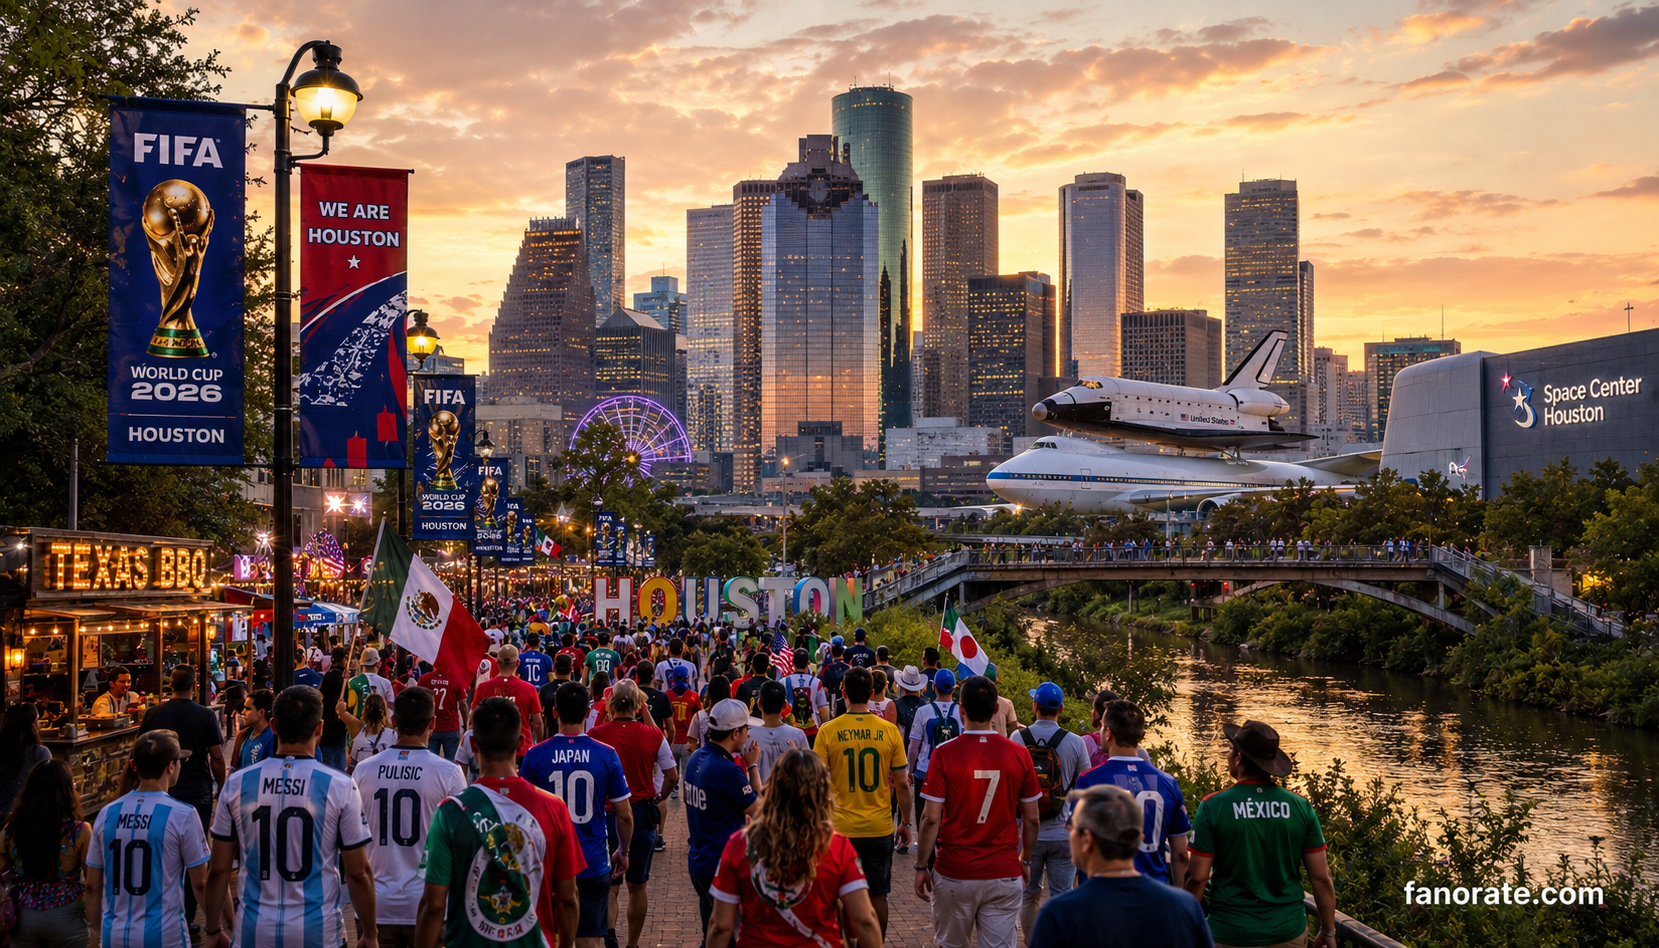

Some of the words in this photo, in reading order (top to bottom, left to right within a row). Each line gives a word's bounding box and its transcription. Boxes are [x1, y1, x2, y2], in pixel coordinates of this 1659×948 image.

[133, 132, 223, 168] FIFA
[319, 201, 348, 218] WE
[353, 203, 390, 220] ARE
[308, 227, 400, 247] HOUSTON
[130, 366, 188, 380] WORLD
[192, 369, 223, 381] CUP
[131, 382, 223, 403] 2026
[423, 389, 466, 405] FIFA
[1544, 384, 1587, 406] Space
[1590, 376, 1642, 399] Center
[1544, 405, 1605, 426] Houston
[128, 426, 225, 444] HOUSTON
[478, 466, 503, 475] FIFA
[422, 501, 466, 511] 2026
[421, 522, 467, 530] HOUSTON
[51, 542, 149, 590] TEXAS
[160, 547, 206, 590] BBQ
[593, 576, 864, 629] HOUSTON
[837, 730, 872, 742] NEYMAR
[874, 731, 884, 742] JR
[551, 750, 590, 764] JAPAN
[378, 762, 423, 780] PULISIC
[843, 747, 880, 793] 10
[263, 778, 306, 796] MESSI
[549, 770, 595, 824] 10
[974, 770, 1000, 824] 7
[374, 788, 421, 847] 10
[1232, 797, 1290, 819] MÉXICO
[117, 813, 153, 829] MESSI
[252, 806, 313, 882] 10
[109, 839, 152, 896] 10
